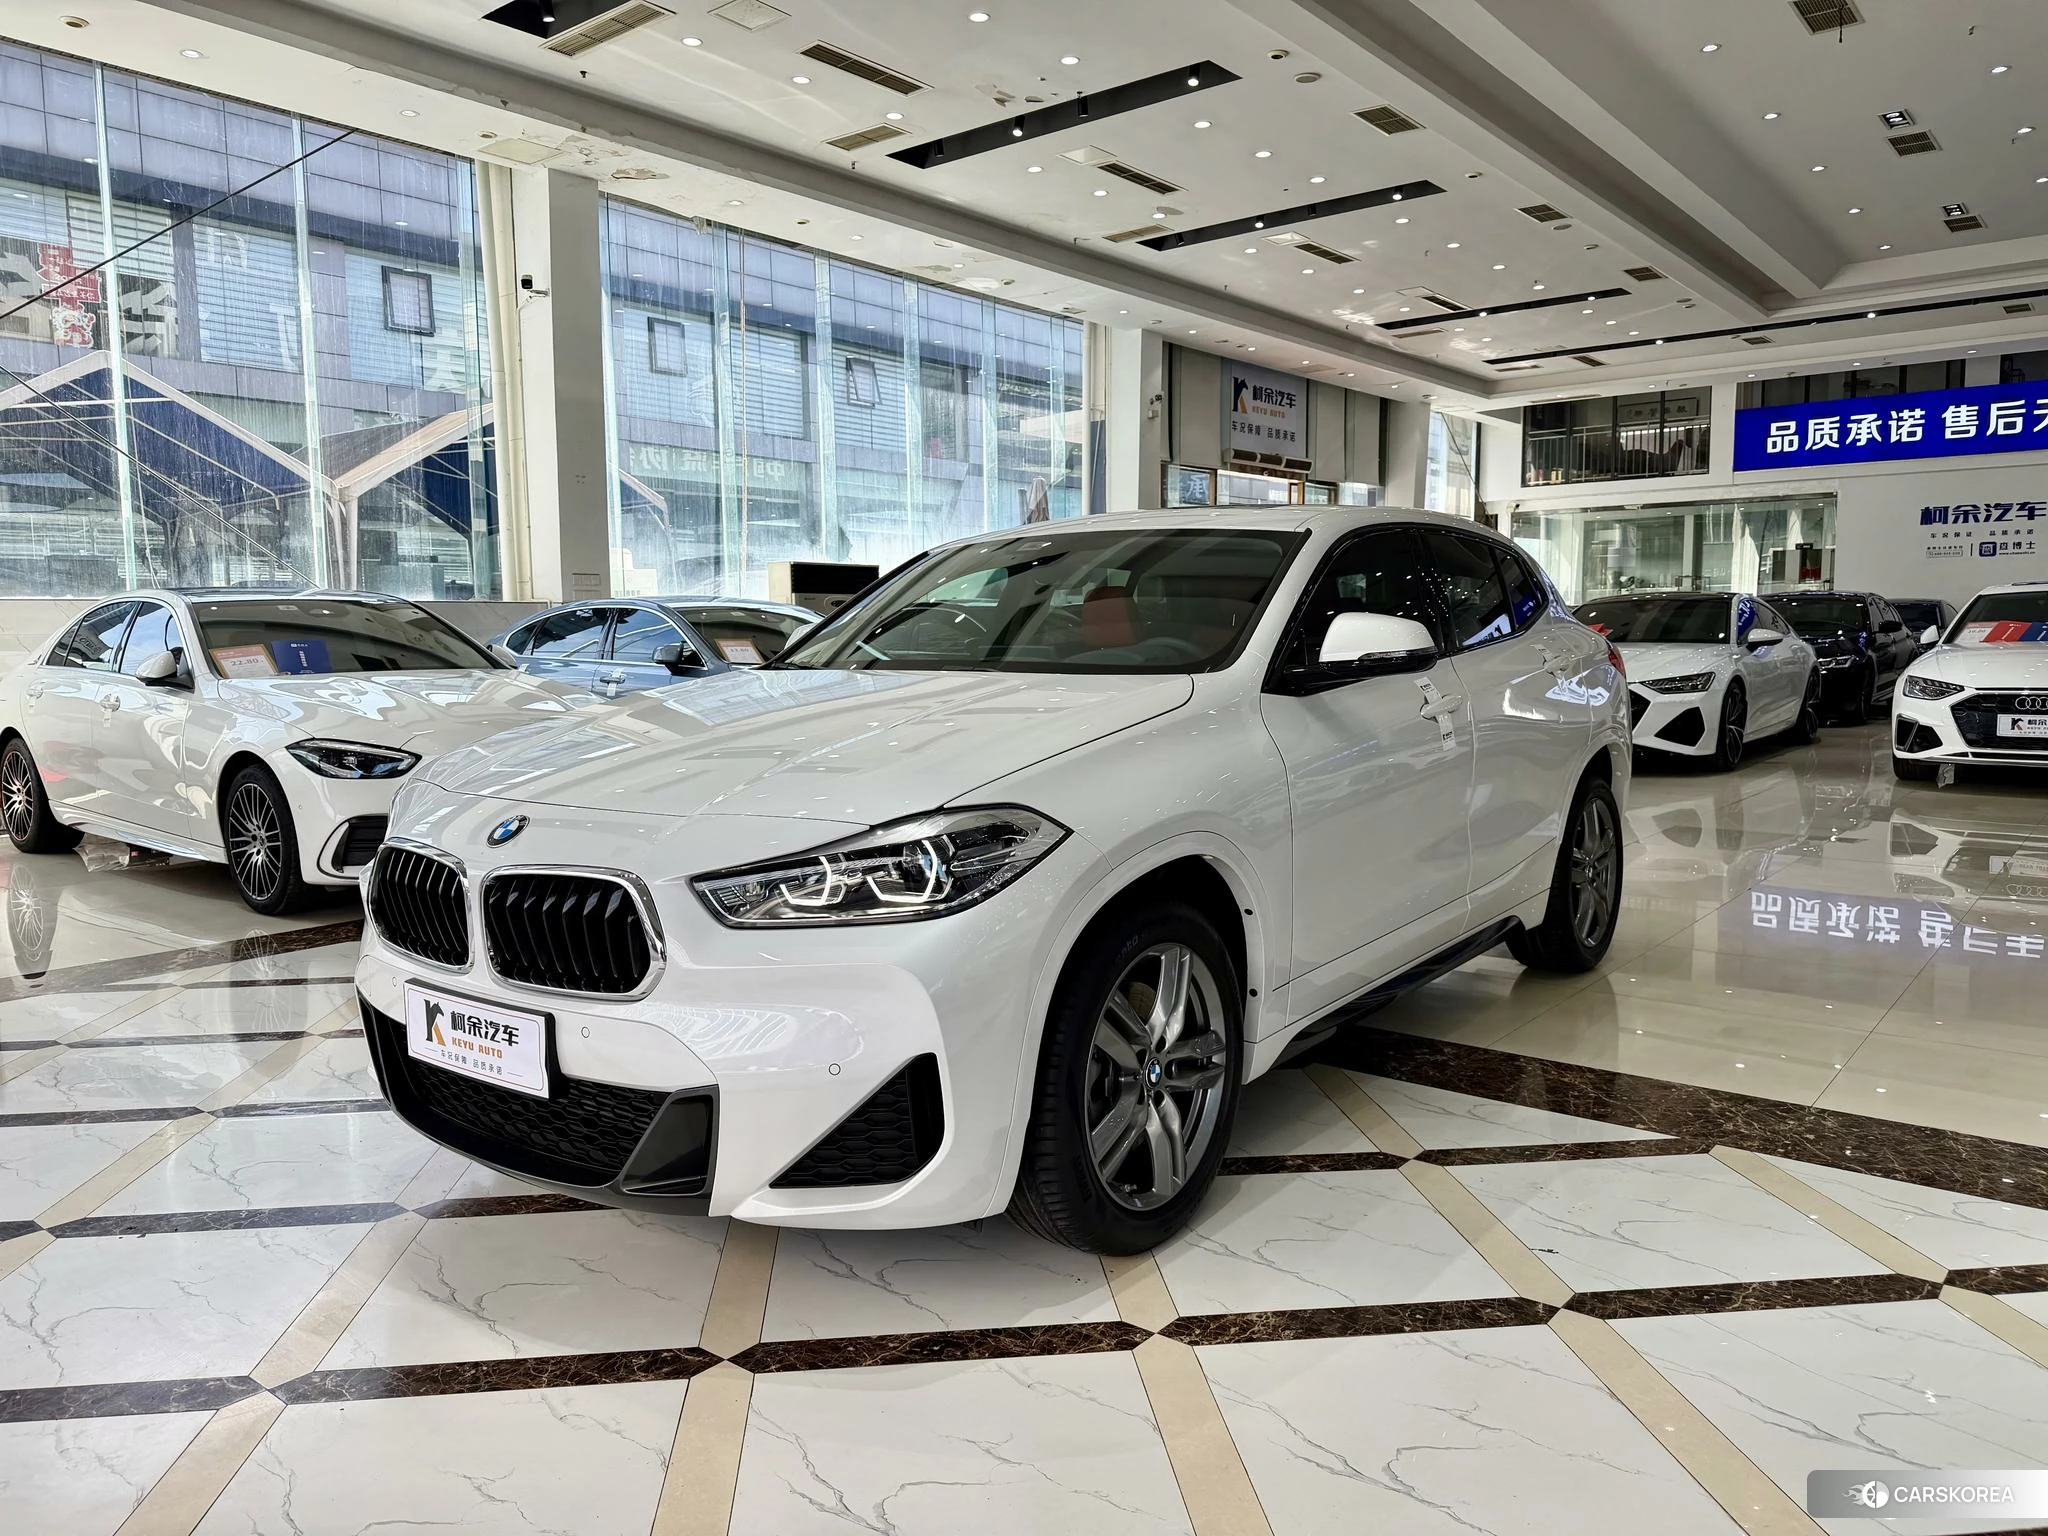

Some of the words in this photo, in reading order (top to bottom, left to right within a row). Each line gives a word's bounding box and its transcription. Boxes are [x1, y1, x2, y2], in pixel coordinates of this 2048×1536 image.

[1252, 384, 1297, 408] 柯余汽车
[1766, 408, 1926, 453] 品质承诺
[1920, 501, 2047, 525] 柯余汽车
[450, 1010, 519, 1047] 柯余汽车
[452, 1036, 474, 1051] KEYU
[478, 1045, 503, 1059] AUTO
